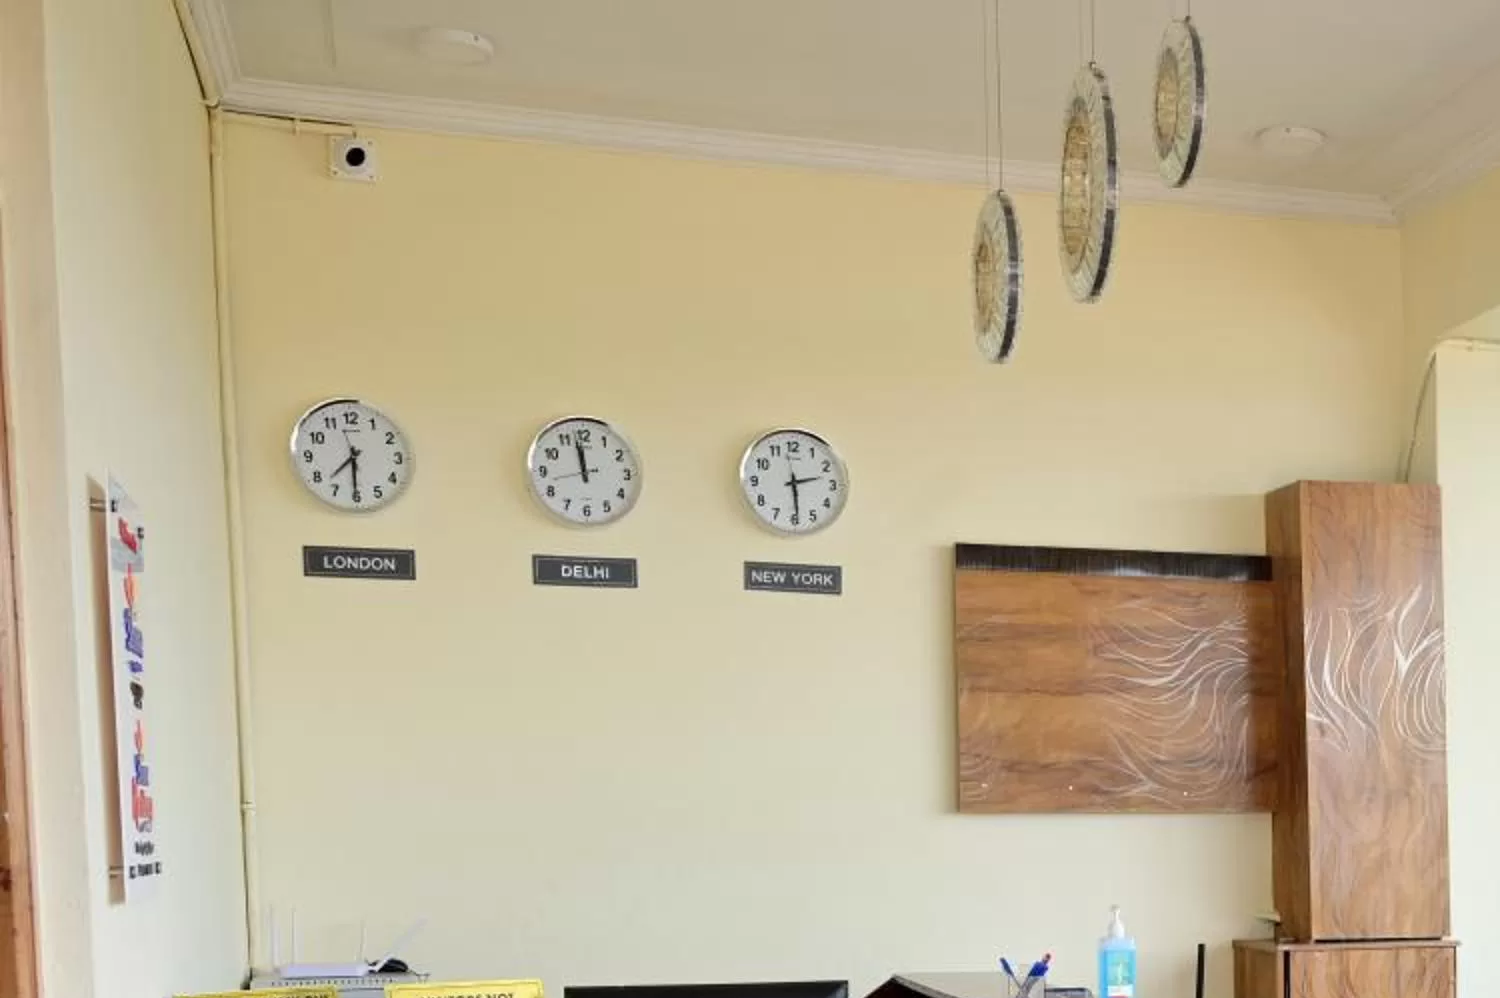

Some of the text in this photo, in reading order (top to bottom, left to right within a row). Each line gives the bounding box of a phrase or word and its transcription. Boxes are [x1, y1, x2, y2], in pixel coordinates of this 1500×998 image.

[324, 417, 337, 430] 11
[342, 411, 359, 425] 12
[368, 417, 376, 431] 1
[309, 431, 325, 445] 10
[385, 431, 395, 445] 2
[559, 433, 571, 446] 11
[577, 429, 591, 443] 12
[601, 435, 607, 448] 1
[544, 447, 559, 460] 10
[769, 445, 781, 457] 11
[786, 441, 800, 453] 12
[810, 447, 815, 459] 1
[303, 449, 313, 463] 9
[393, 451, 403, 465] 3
[615, 449, 624, 462] 2
[756, 458, 769, 471] 10
[821, 460, 831, 473] 2
[313, 471, 323, 483] 8
[388, 471, 397, 485] 4
[538, 465, 547, 478] 9
[623, 467, 631, 481] 3
[750, 475, 759, 487] 9
[829, 479, 837, 491] 3
[330, 483, 340, 497] 7
[373, 485, 383, 498] 5
[546, 485, 555, 497] 8
[616, 487, 625, 499] 4
[563, 498, 571, 511] 7
[603, 500, 611, 513] 5
[757, 494, 765, 507] 8
[823, 497, 831, 508] 4
[583, 505, 591, 517] 6
[772, 507, 780, 520] 7
[809, 509, 817, 522] 5
[323, 555, 396, 571] LONDON
[561, 565, 609, 579] DELHI
[751, 569, 833, 586] NEW YORK
